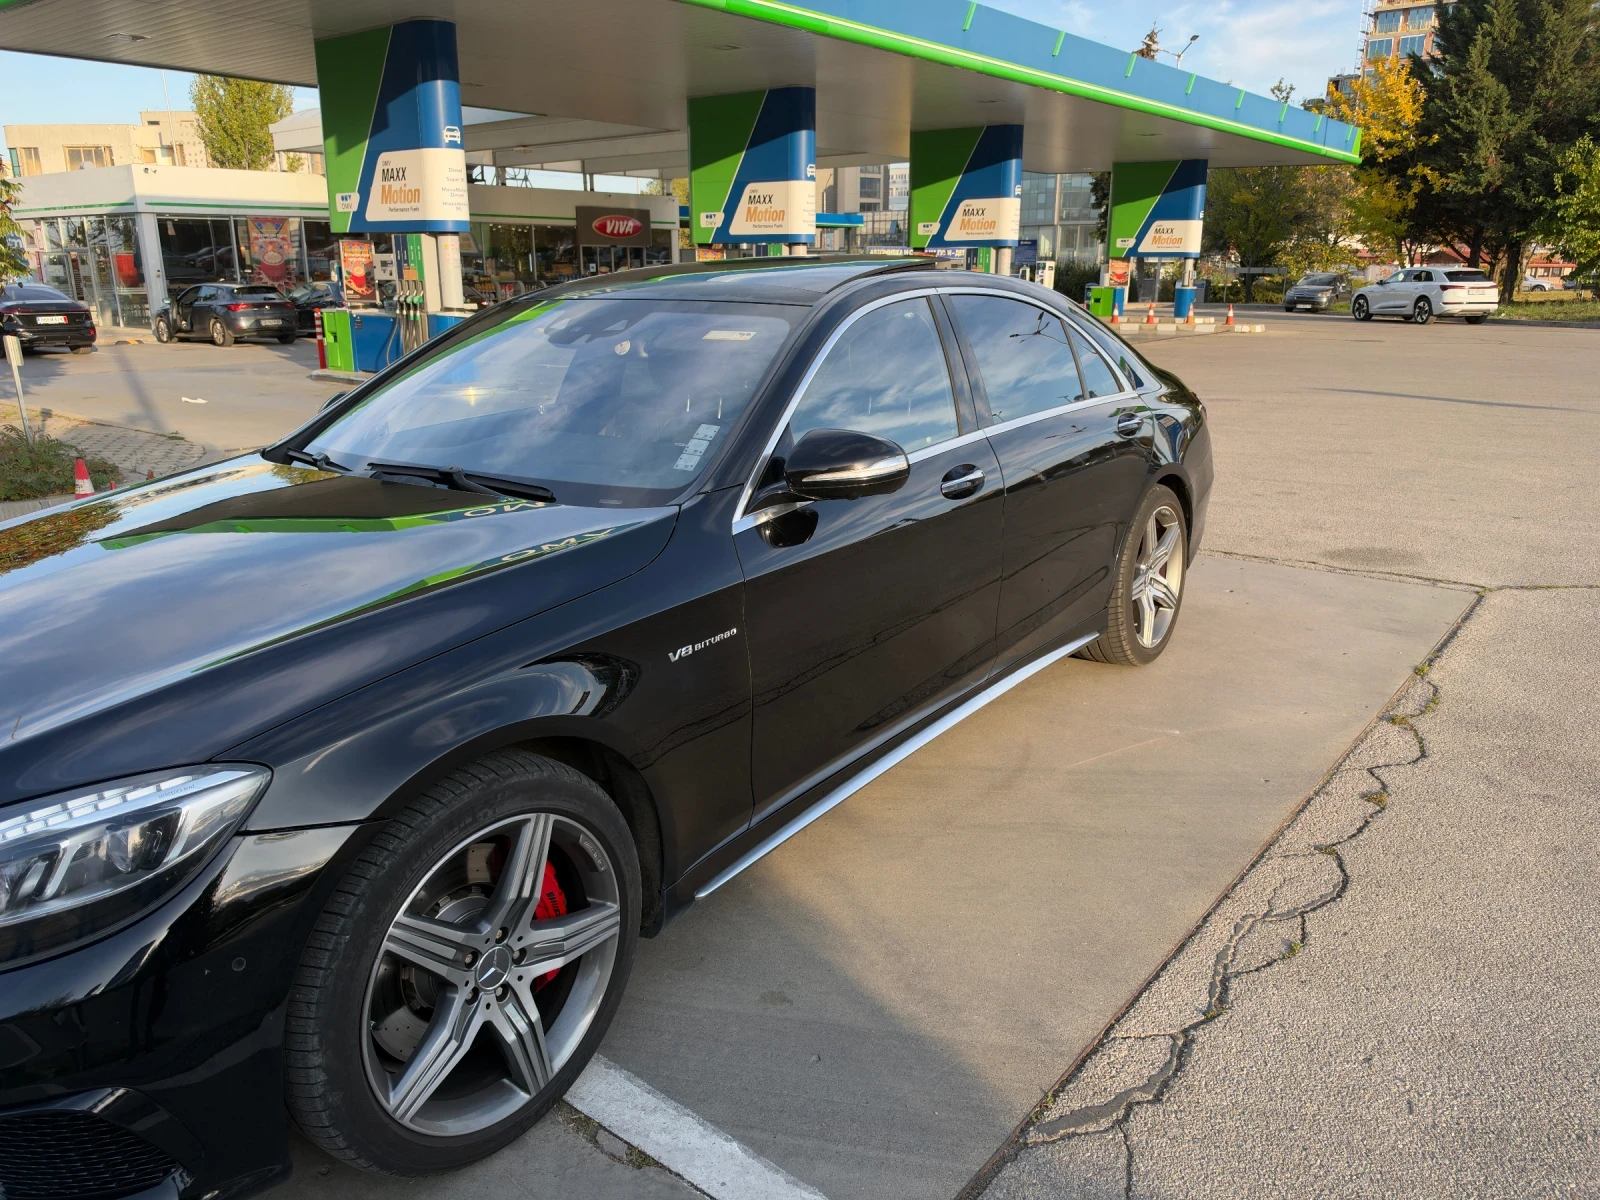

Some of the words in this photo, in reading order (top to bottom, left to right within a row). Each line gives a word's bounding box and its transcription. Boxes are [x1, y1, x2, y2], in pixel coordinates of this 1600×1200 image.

[382, 167, 407, 183] MAXX
[381, 183, 421, 205] Motion
[748, 195, 774, 205] MAXX
[746, 206, 785, 222] Motion
[962, 208, 986, 217] MAXX
[606, 220, 634, 234] VIVA
[959, 218, 997, 231] Motion
[1151, 236, 1183, 244] Motion
[668, 644, 693, 663] V8
[694, 627, 737, 652] BITURBO
